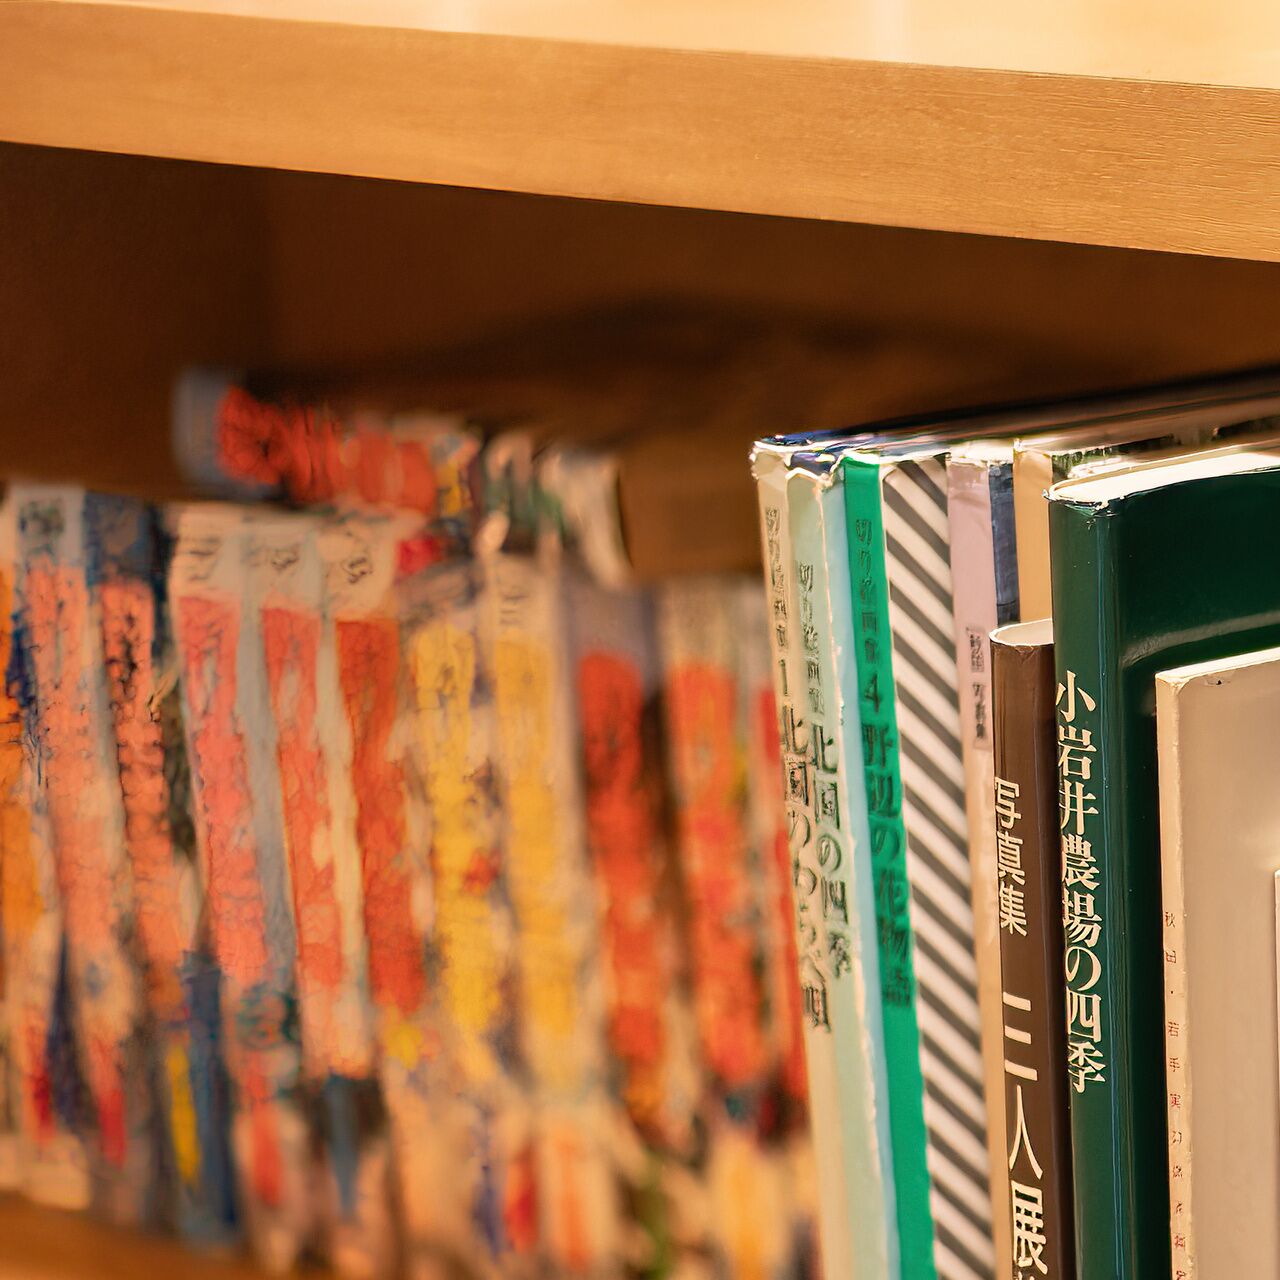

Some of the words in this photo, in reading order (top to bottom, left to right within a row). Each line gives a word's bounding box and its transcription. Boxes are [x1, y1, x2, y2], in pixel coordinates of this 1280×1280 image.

[993, 776, 1028, 937] 写真集
[1055, 670, 1105, 1094] 小岩井農場の四季
